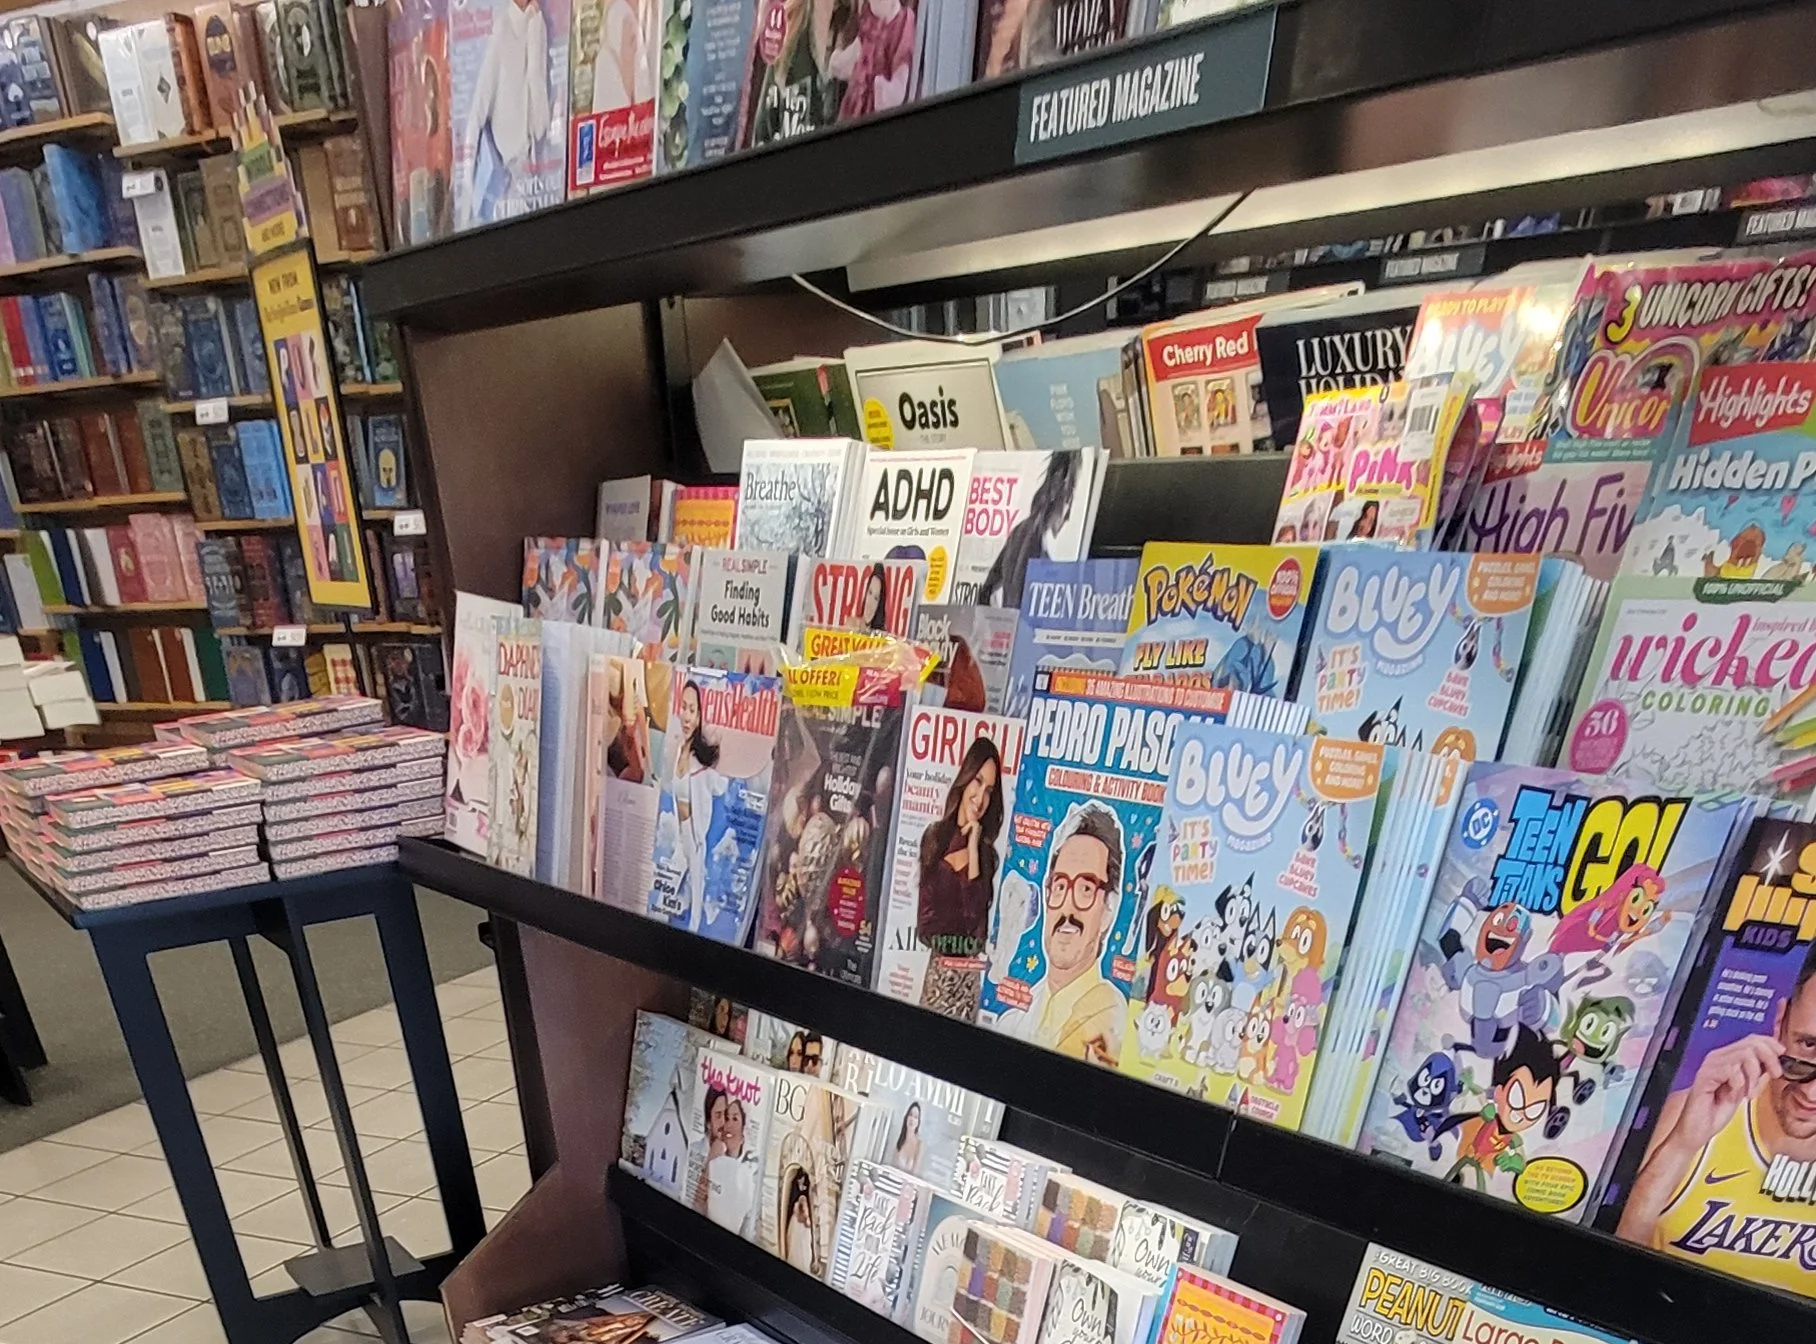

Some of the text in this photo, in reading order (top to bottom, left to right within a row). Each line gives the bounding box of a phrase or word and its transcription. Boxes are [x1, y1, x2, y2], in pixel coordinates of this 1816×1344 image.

[1030, 52, 1205, 143] FEATURED MAGAZINE
[1606, 262, 1815, 344] 3 UNICORN GIFTS!
[1162, 331, 1249, 367] Cherry Red
[1296, 325, 1413, 378] LUXURY
[899, 385, 960, 431] Oasis
[1699, 374, 1813, 430] Highlights
[744, 471, 798, 503] Breathe
[1669, 450, 1789, 493] Hidden
[868, 467, 956, 522] ADHD
[968, 476, 1020, 507] BEST
[963, 508, 1021, 536] BODY
[1470, 471, 1637, 556] High Fiv
[723, 579, 761, 608] Finding
[1028, 582, 1077, 619] TEEN
[1326, 563, 1461, 660] BLUEY
[711, 603, 770, 629] Good Habits
[917, 613, 952, 641] Black
[811, 633, 850, 657] GREAT
[1133, 638, 1209, 671] FLY LIKE
[800, 668, 842, 686] OFFER!
[731, 681, 779, 737] Health
[1640, 690, 1772, 718] COLORING
[1024, 696, 1108, 766] PEDRO
[1583, 708, 1620, 738] 50
[824, 772, 862, 800] Holiday
[902, 783, 941, 800] beauty
[1047, 766, 1094, 792] COLOURING
[1101, 775, 1142, 799] ACTIVITY
[1175, 739, 1304, 837] BLUEY
[900, 800, 945, 817] mantra
[1470, 810, 1493, 836] DC
[1506, 786, 1588, 864] TEEN
[1182, 818, 1212, 838] IT'S
[1560, 796, 1691, 917] GO!
[1277, 876, 1320, 898] CUPCAKES
[1488, 858, 1565, 914] TITANS
[1740, 924, 1795, 951] KIDS
[699, 1056, 762, 1107] the knot
[775, 1078, 808, 1122] BG
[1133, 1238, 1169, 1276] Own
[1378, 1251, 1419, 1275] GREAT
[1418, 1267, 1441, 1283] BIG
[1441, 1275, 1473, 1298] BOOK
[1071, 1298, 1104, 1336] Own
[1358, 1266, 1468, 1342] PEANUT
